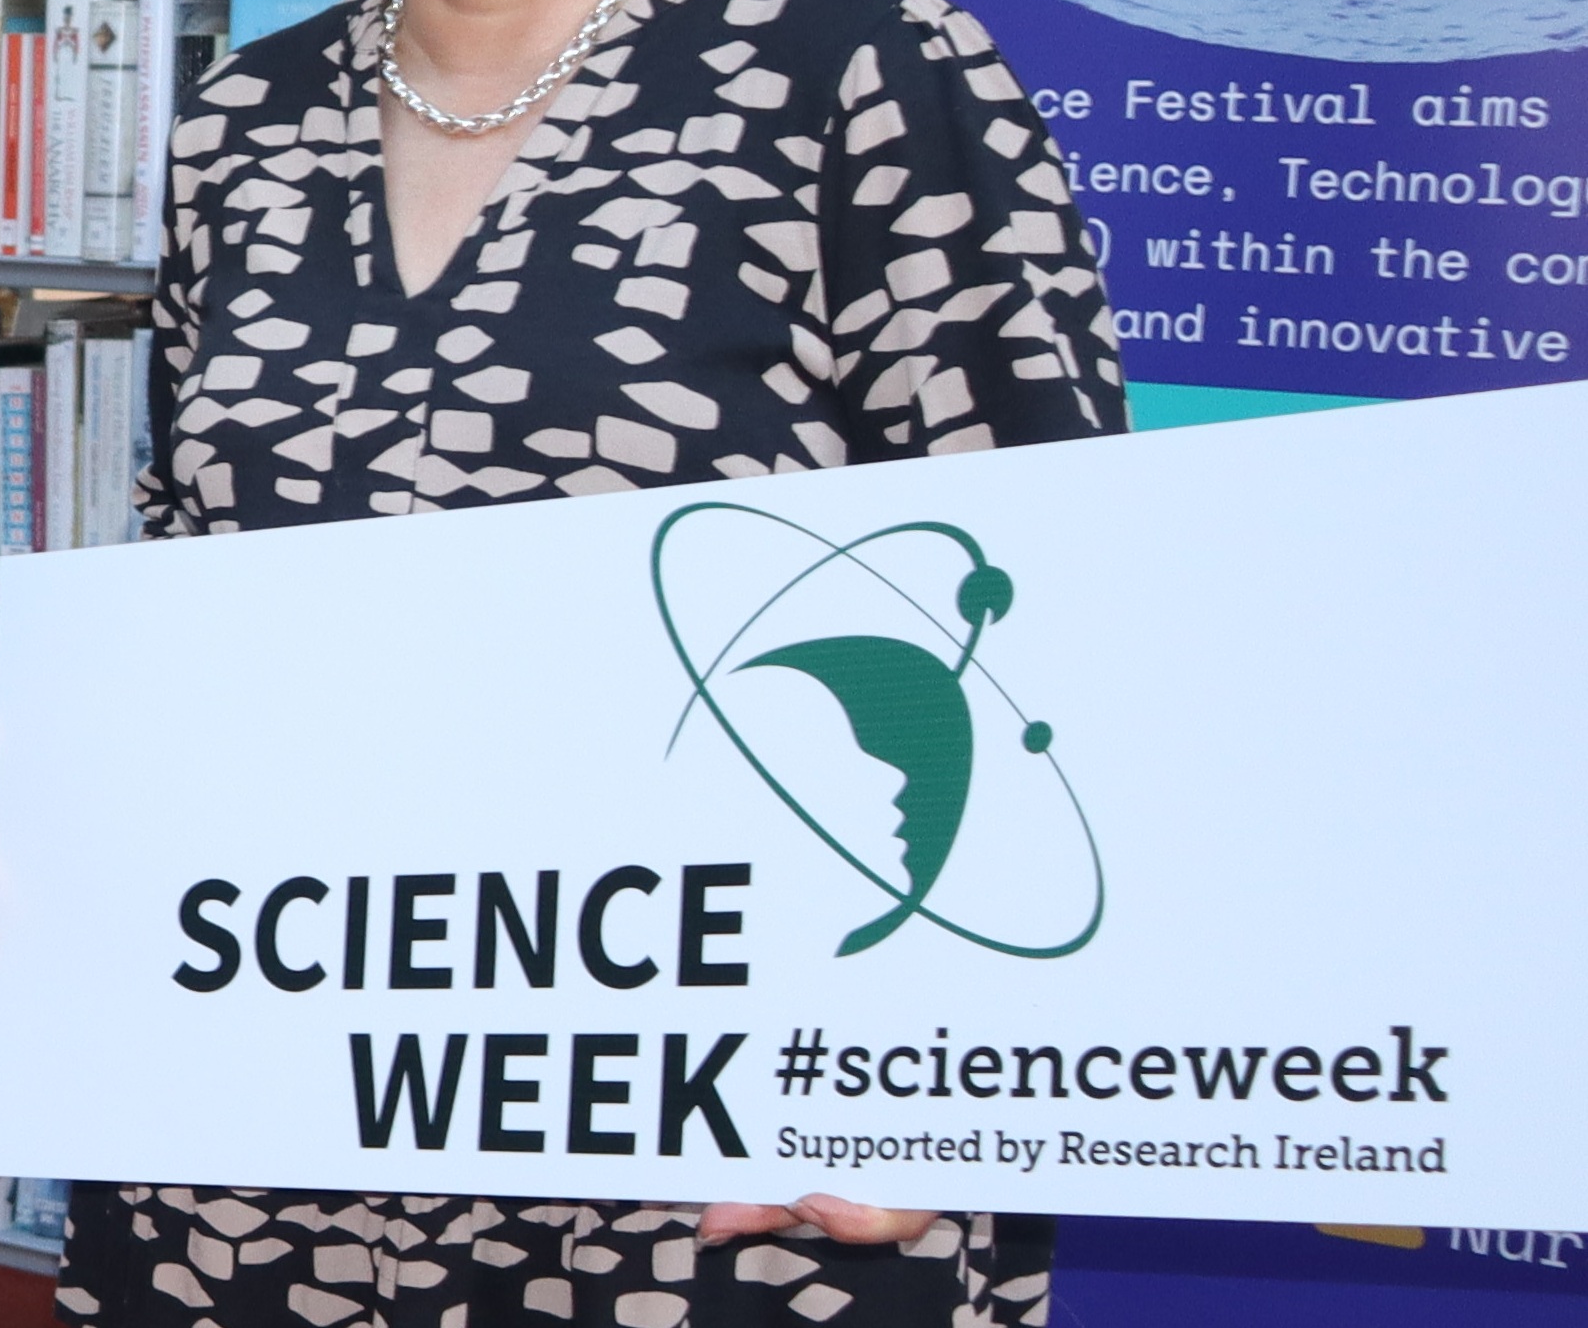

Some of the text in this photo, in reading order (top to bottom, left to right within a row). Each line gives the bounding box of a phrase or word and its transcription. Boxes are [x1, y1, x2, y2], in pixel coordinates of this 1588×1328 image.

[137, 16, 151, 162] PATIENT ASSASSIN
[1125, 79, 1549, 129] Festival aims
[1277, 157, 1588, 219] Technolog
[1146, 229, 1334, 276] within
[1370, 238, 1470, 284] the
[1110, 303, 1570, 364] and innovative
[171, 863, 753, 995] SCIENCE
[774, 1024, 1451, 1104] #scienceweek
[349, 1032, 750, 1161] WEEK
[775, 1125, 1448, 1174] Supported by Research Ireland
